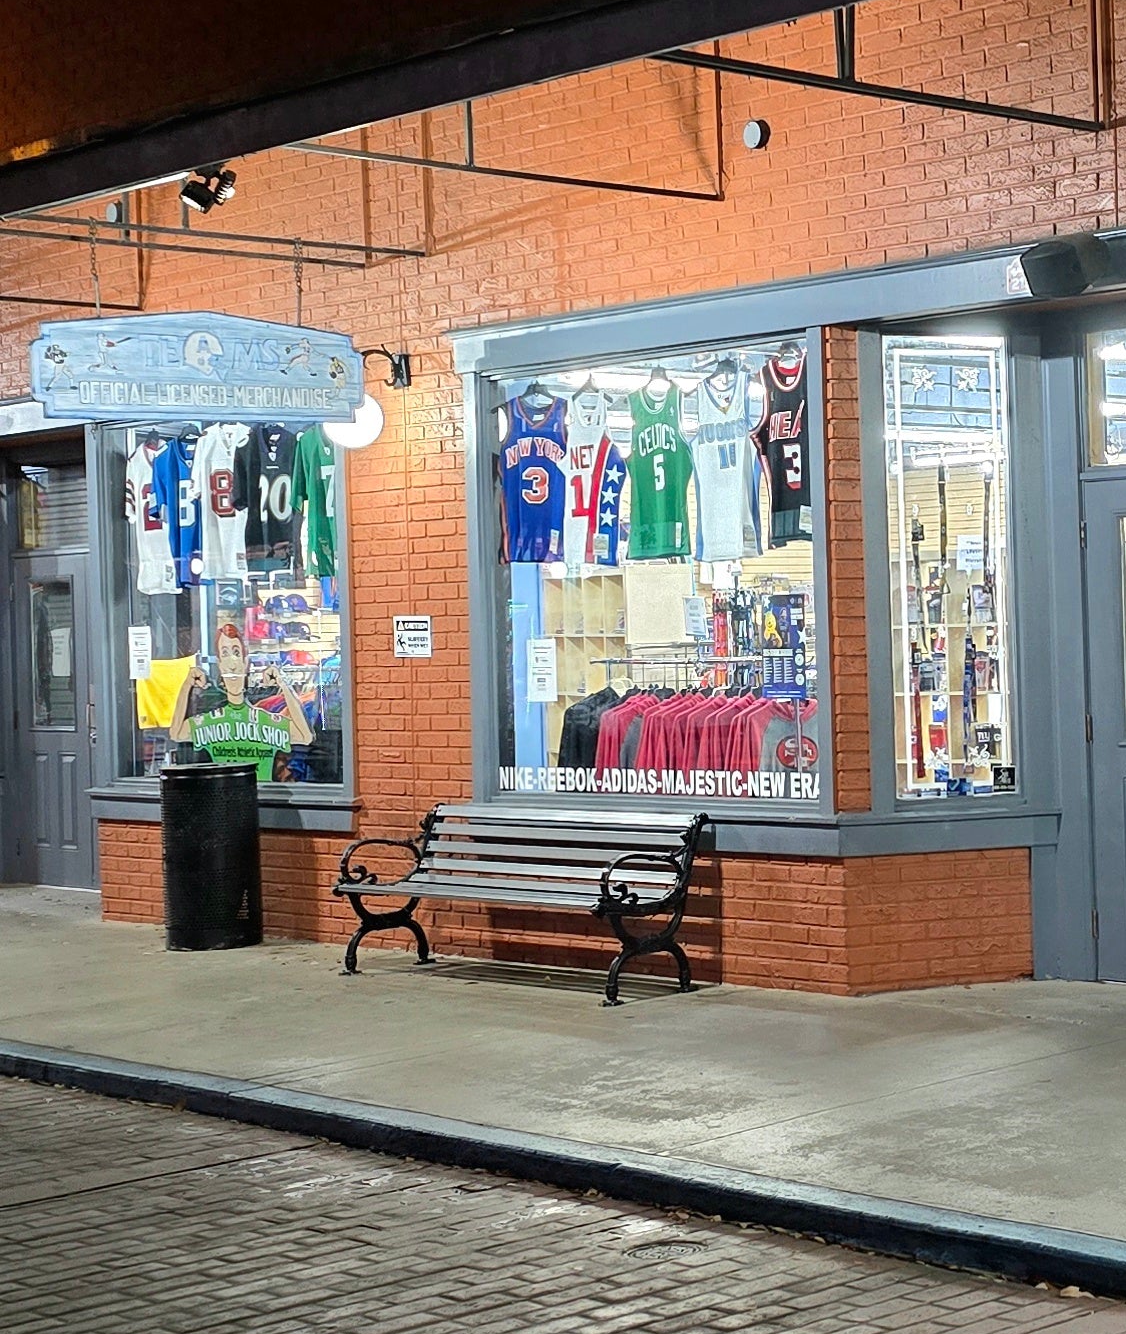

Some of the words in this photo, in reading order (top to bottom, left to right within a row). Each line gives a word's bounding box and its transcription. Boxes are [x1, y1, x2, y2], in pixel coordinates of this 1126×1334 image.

[137, 332, 281, 372] TEAMS
[79, 380, 153, 405] OFFICIAL
[155, 383, 228, 407] LICENSED
[232, 386, 334, 410] MERCHANDISE
[521, 467, 549, 504] 3
[653, 454, 665, 491] 5
[195, 722, 232, 748] JUNIOR
[233, 721, 261, 742] JOCK
[261, 724, 290, 749] SHOP
